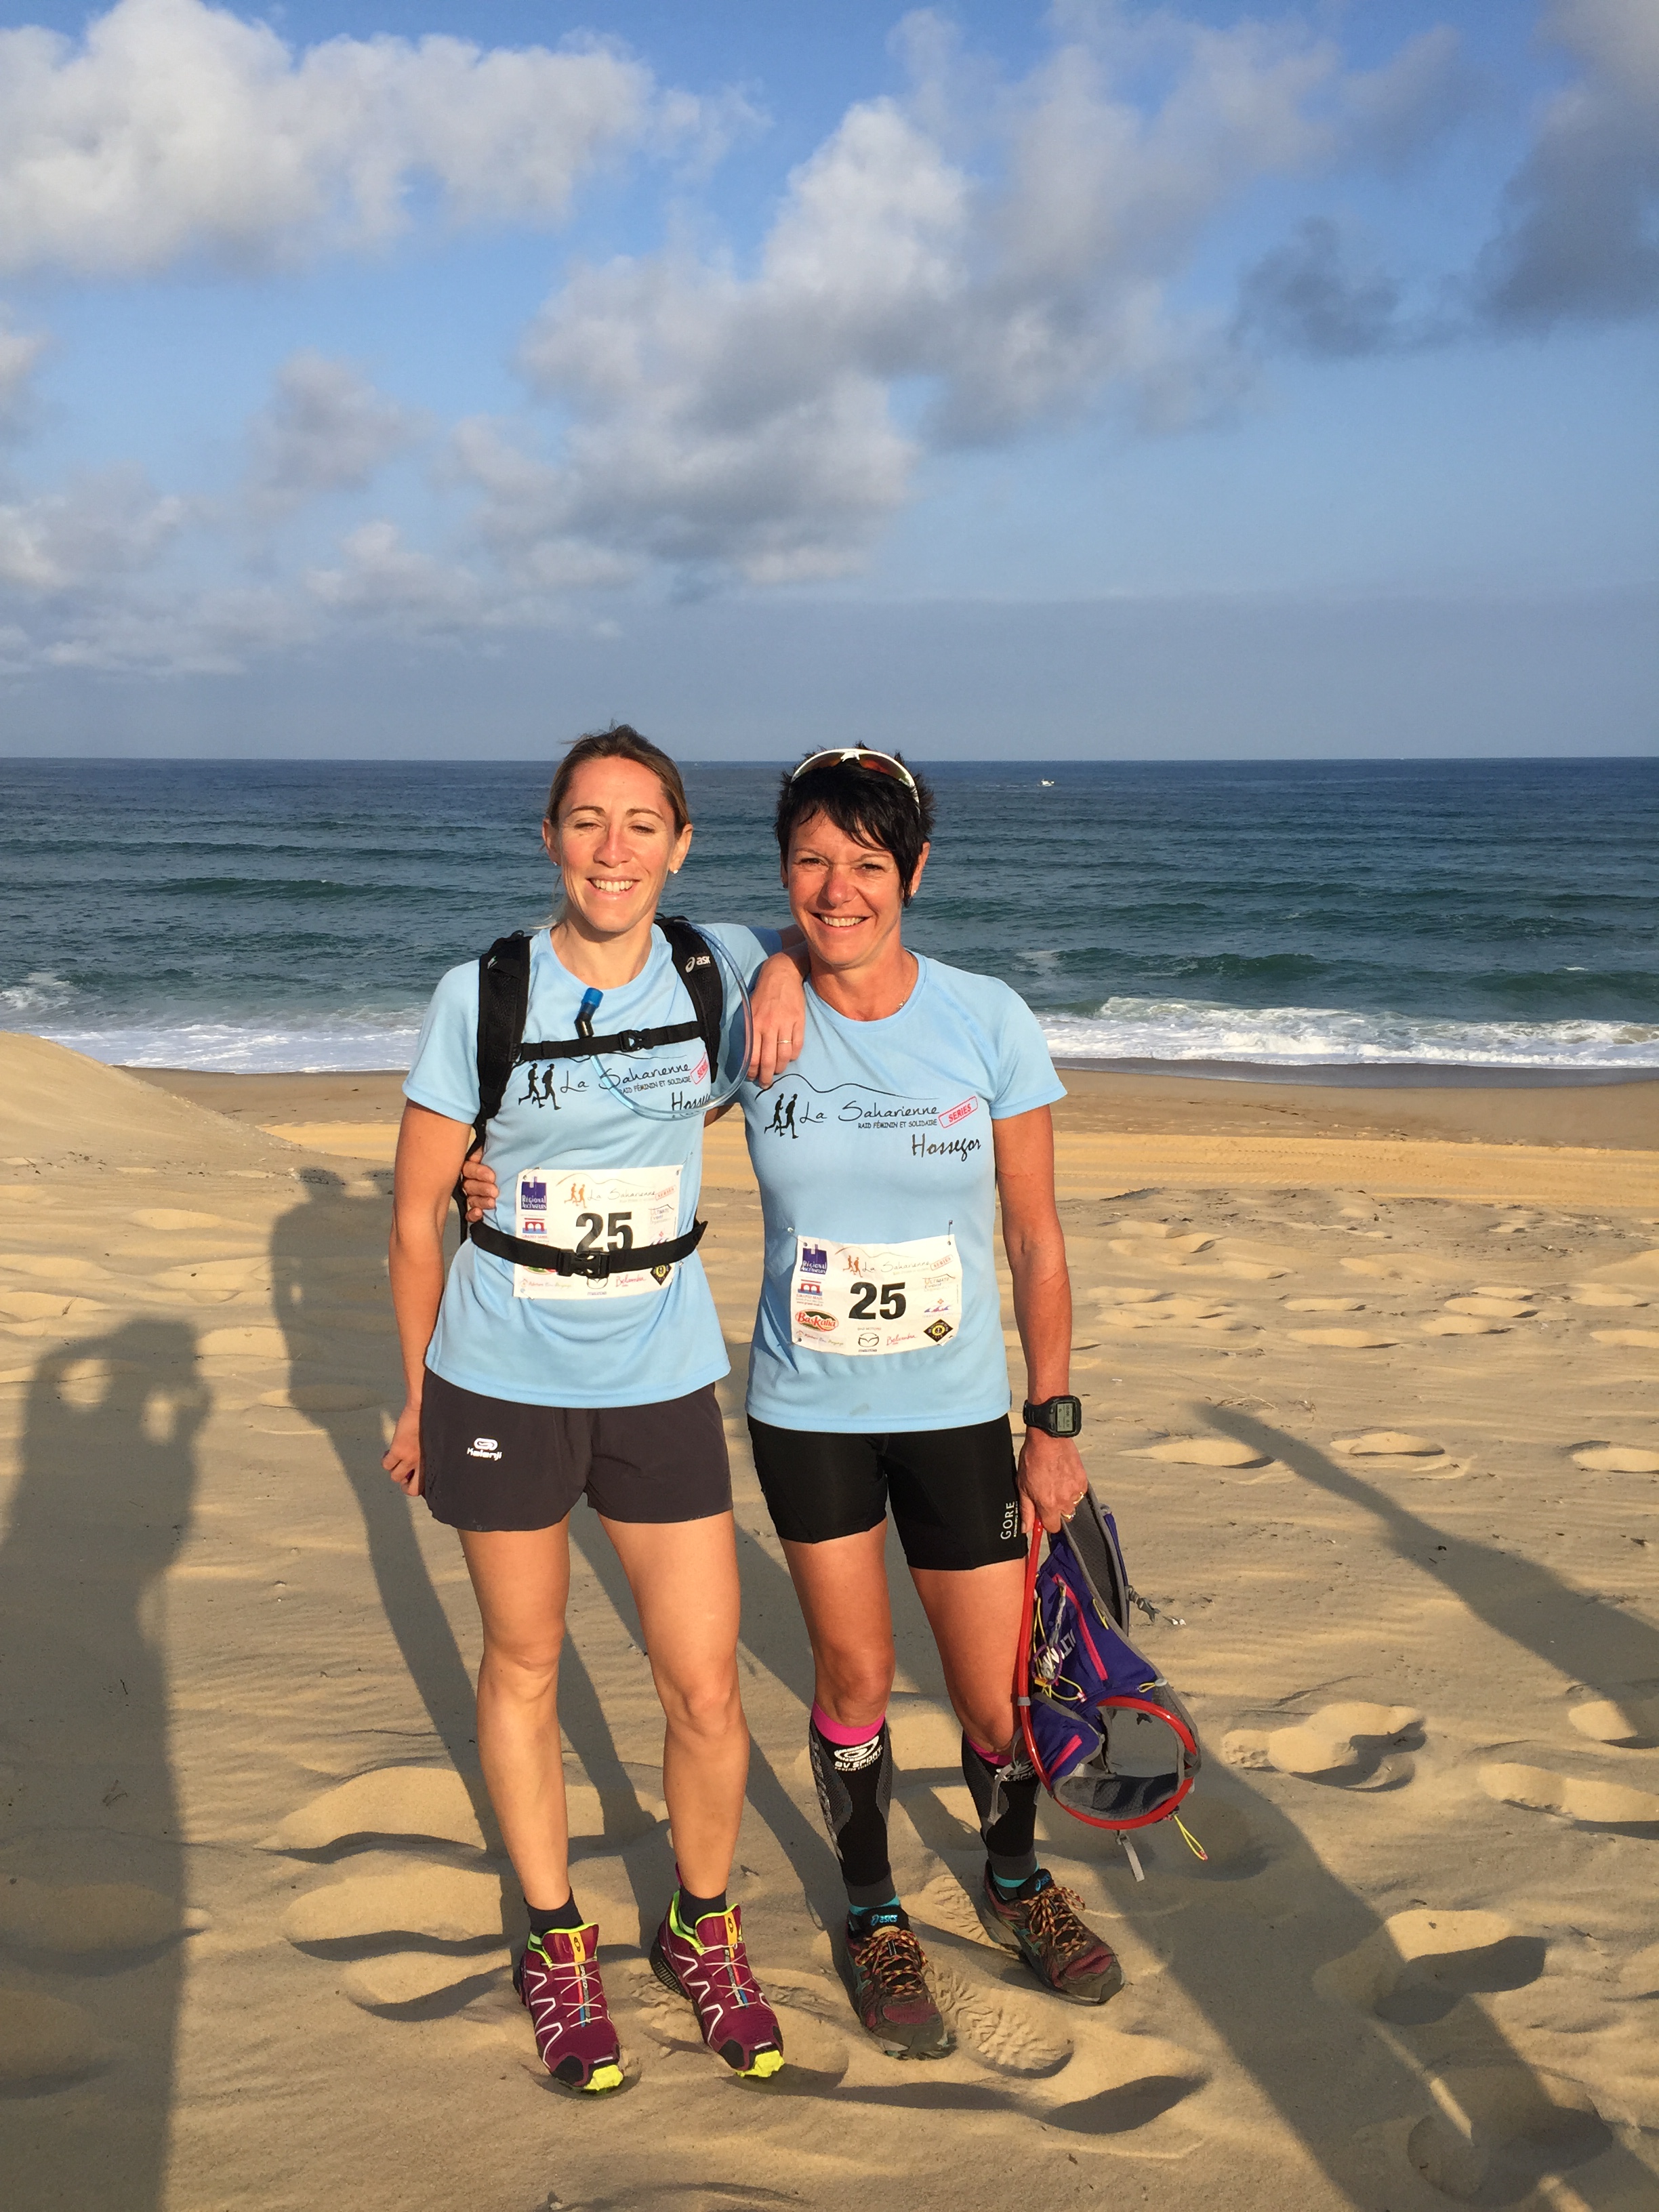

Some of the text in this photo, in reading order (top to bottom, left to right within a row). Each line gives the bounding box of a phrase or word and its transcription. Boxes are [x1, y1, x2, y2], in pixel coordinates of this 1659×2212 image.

[560, 1070, 589, 1093] La
[667, 1076, 692, 1086] SOLIDAIRE
[799, 1100, 972, 1124] La Saharienne SERIES
[873, 1120, 898, 1129] FÉMININ
[899, 1120, 907, 1128] ET
[907, 1118, 938, 1128] SOLIDAIRE
[911, 1133, 982, 1162] Hossegor
[587, 1189, 602, 1201] La
[607, 1188, 655, 1200] Saharienne
[575, 1211, 634, 1252] 25
[861, 1261, 876, 1273] La
[880, 1261, 930, 1273] Saharienne
[848, 1282, 906, 1320] 25
[466, 1447, 502, 1461] Kalenji
[1000, 1500, 1015, 1540] GORE
[879, 1914, 898, 1923] asics
